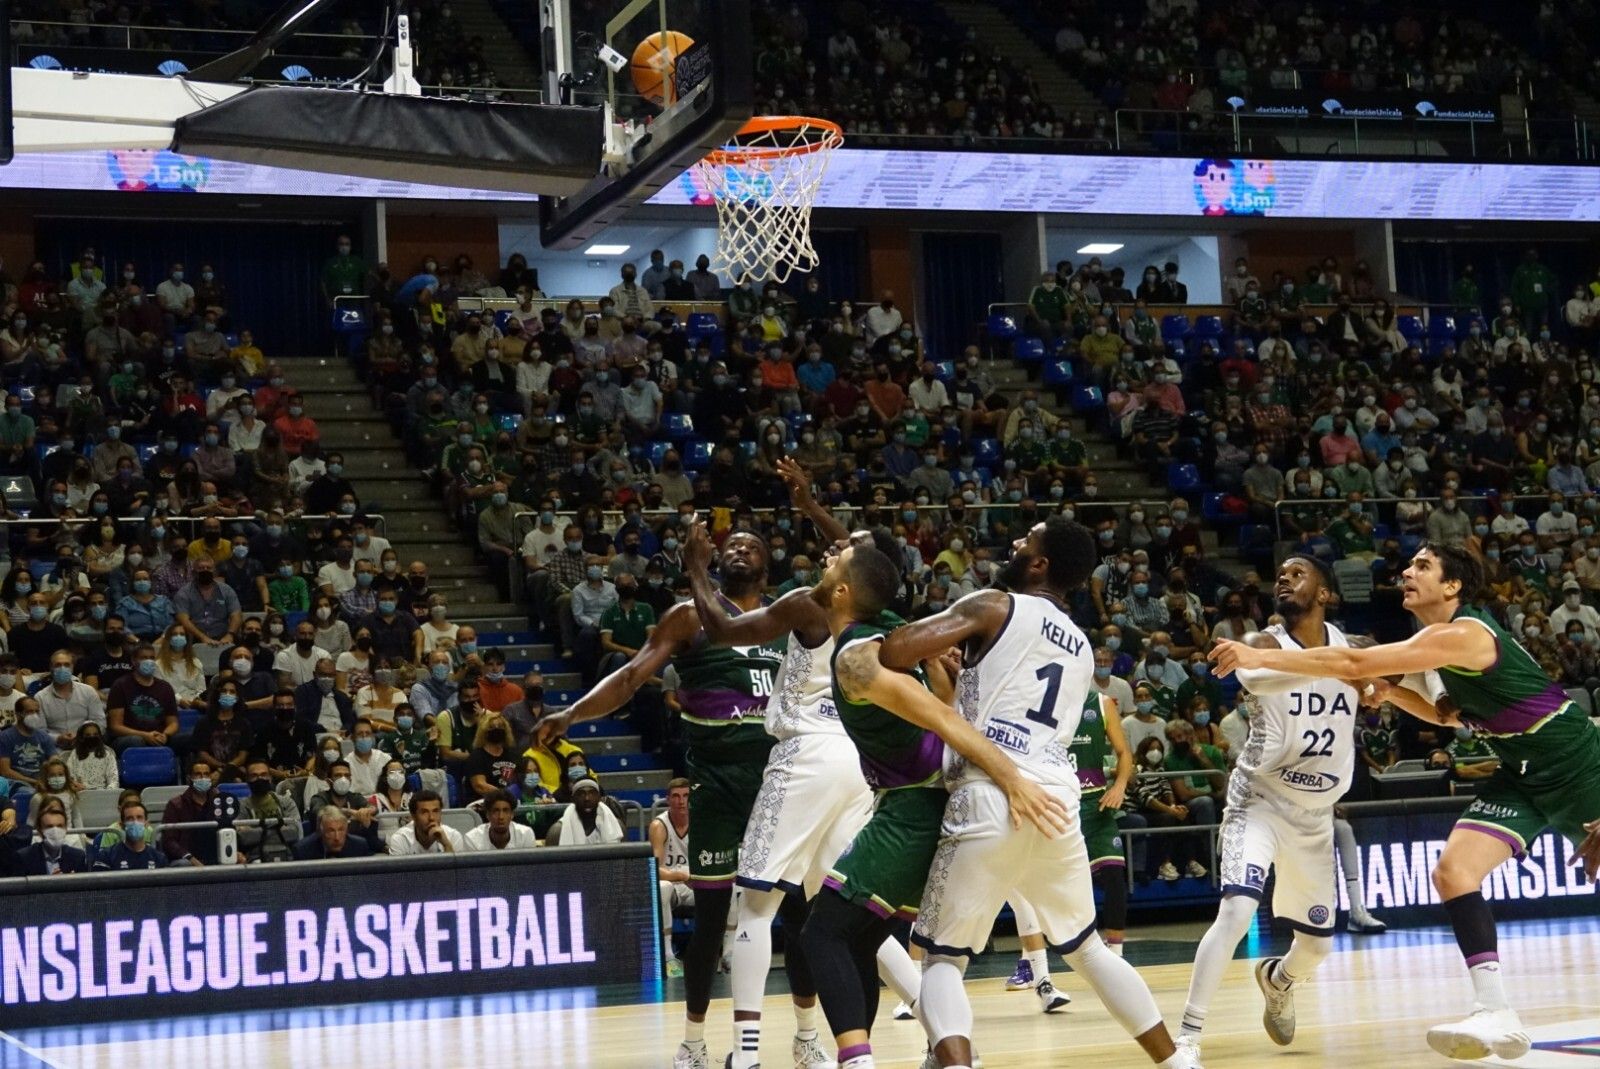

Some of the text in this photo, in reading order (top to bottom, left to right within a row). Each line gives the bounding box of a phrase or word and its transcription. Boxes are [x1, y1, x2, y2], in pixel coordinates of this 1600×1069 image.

[1041, 617, 1084, 656] KELLY
[749, 669, 773, 697] 50
[1025, 662, 1064, 729] 1
[1289, 693, 1351, 716] JDA
[985, 726, 1029, 752] DELIN
[1299, 728, 1336, 758] 22
[665, 854, 687, 867] JD
